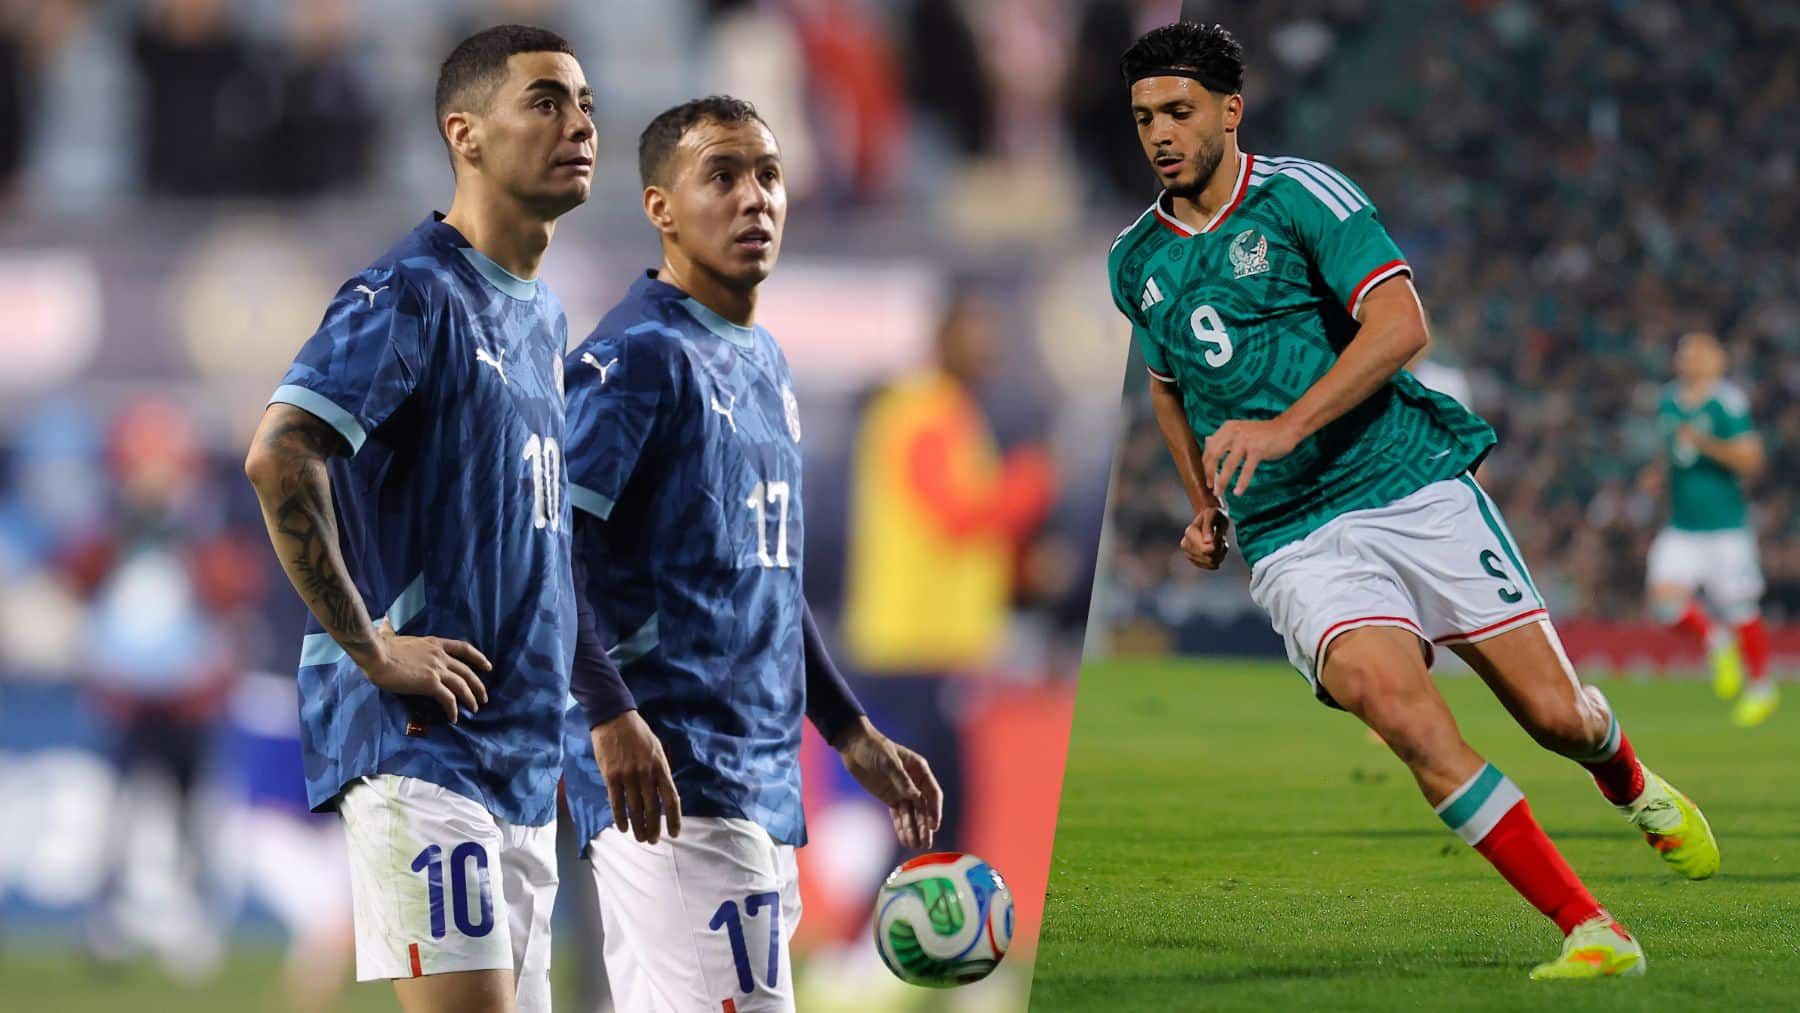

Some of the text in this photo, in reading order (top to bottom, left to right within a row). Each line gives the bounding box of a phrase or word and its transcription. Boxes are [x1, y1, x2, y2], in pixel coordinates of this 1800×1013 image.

[1190, 304, 1233, 368] 9
[523, 433, 560, 531] 10
[746, 481, 790, 568] 17
[411, 842, 494, 938] 10
[709, 892, 780, 994] 17
